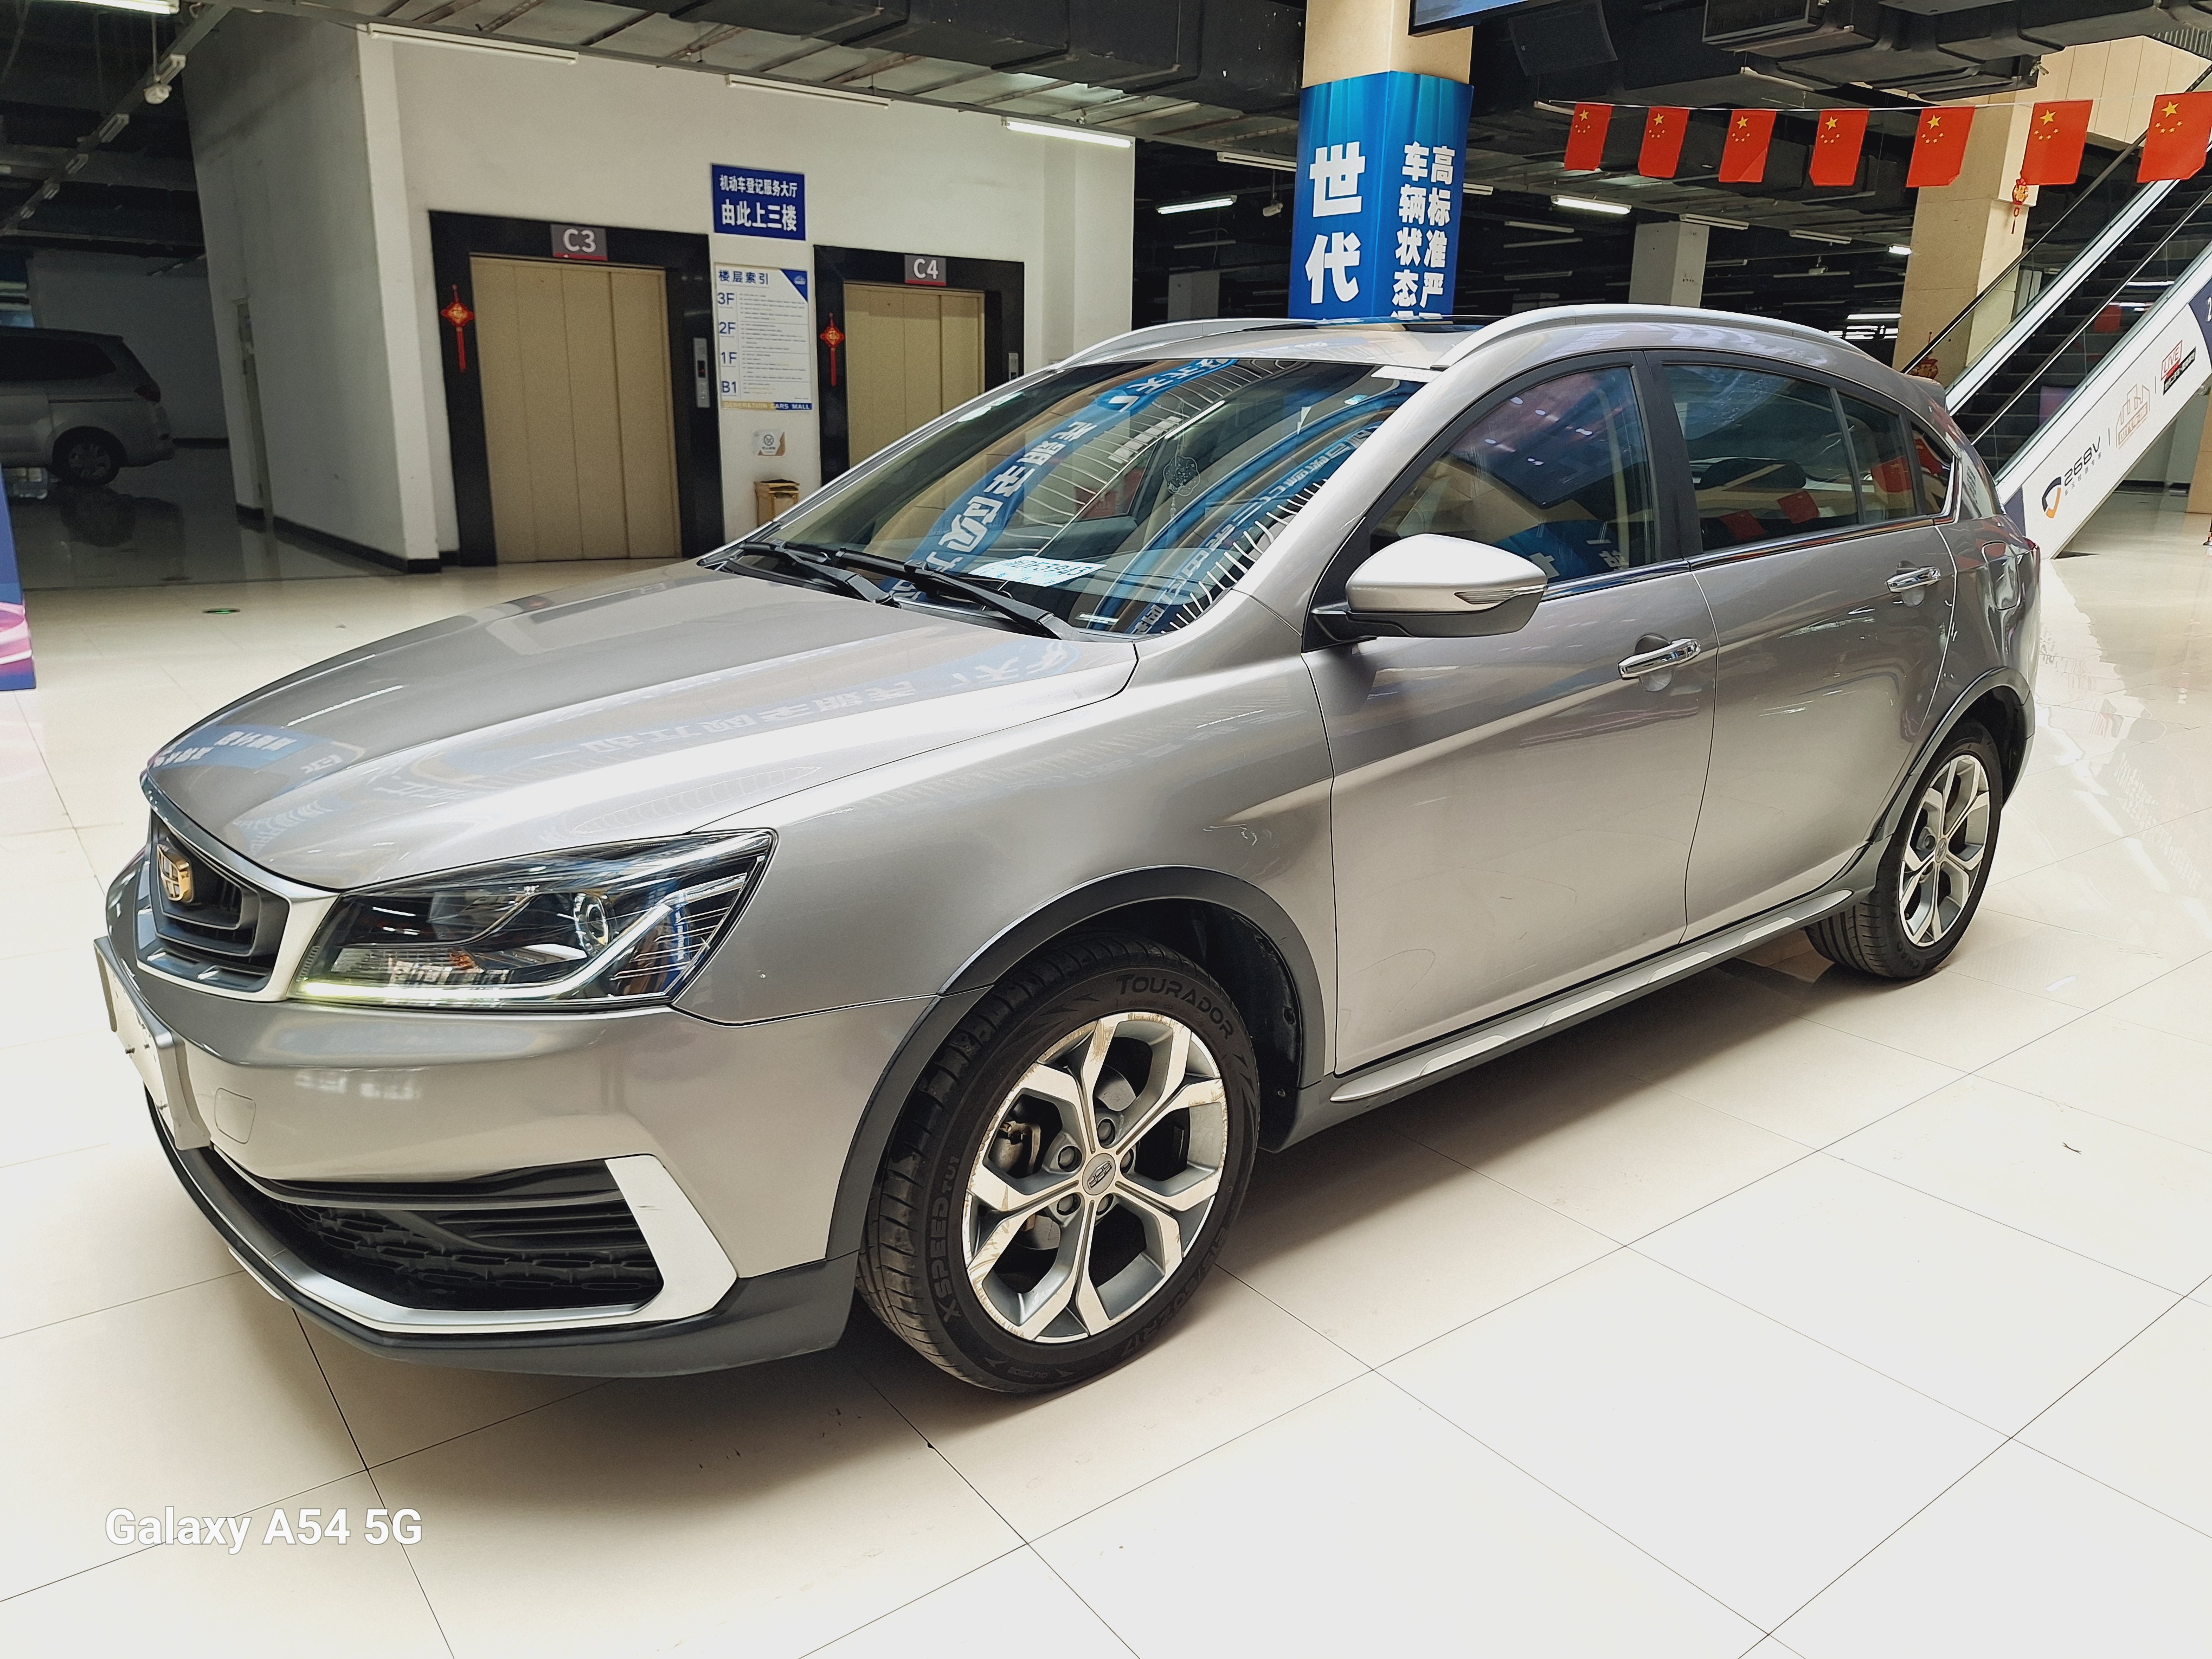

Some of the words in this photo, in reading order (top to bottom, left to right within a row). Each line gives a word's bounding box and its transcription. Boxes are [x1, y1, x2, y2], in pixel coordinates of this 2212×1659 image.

[719, 174, 798, 198] 机动车登记服务大厅
[721, 198, 797, 232] 由此上三楼
[1305, 141, 1366, 304] 世代
[563, 228, 596, 253] C3
[1391, 141, 1430, 319] 车辆状态
[1419, 145, 1456, 319] 高标准严
[719, 269, 768, 285] 楼层索引
[914, 258, 939, 279] C4
[717, 292, 735, 305] 3F
[719, 321, 736, 335] 2F
[721, 352, 737, 364] 1F
[722, 381, 737, 394] B1
[2064, 435, 2101, 487] 268V
[1116, 973, 1234, 1040] TOURADOR
[930, 1197, 953, 1298] SPEED
[937, 1298, 962, 1323] X
